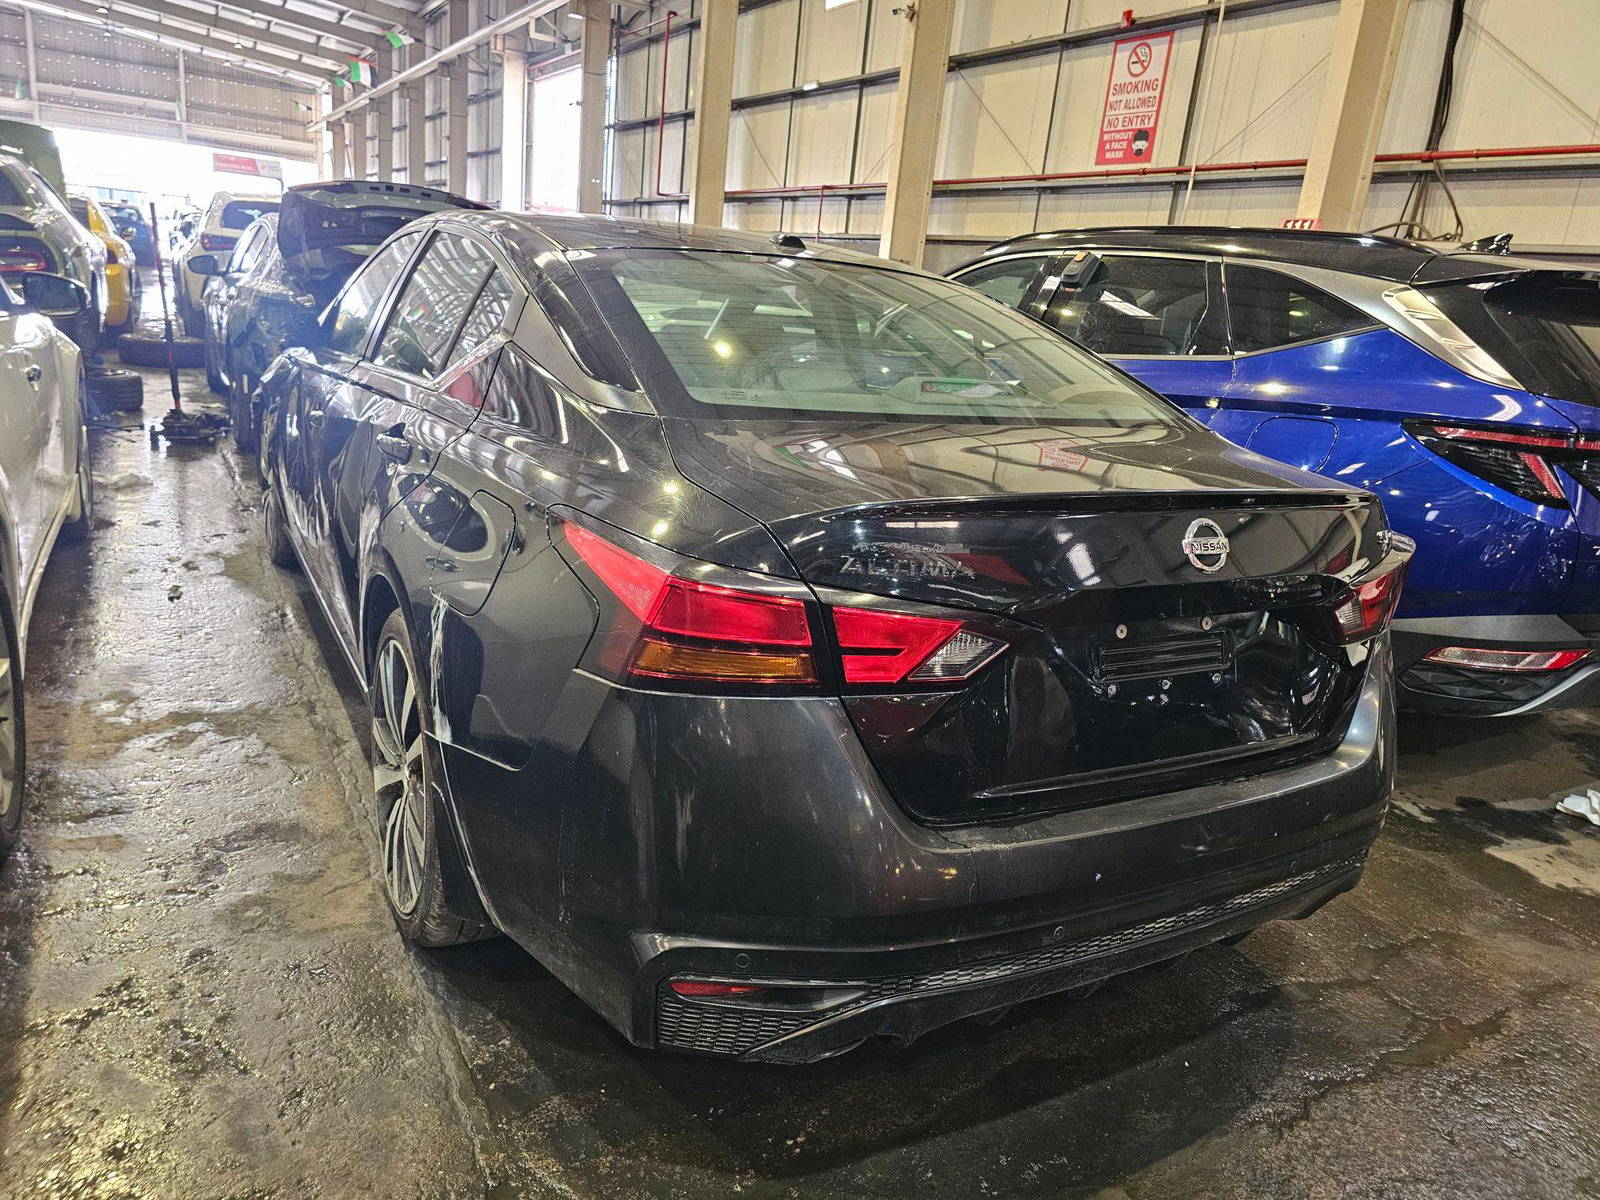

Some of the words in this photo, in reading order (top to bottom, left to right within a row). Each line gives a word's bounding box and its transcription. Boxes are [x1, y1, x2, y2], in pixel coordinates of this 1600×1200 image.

[1112, 79, 1159, 96] SMOKING
[1108, 99, 1123, 112] NOT
[1123, 96, 1157, 110] ALLOWED
[1106, 116, 1119, 129] NO
[1121, 114, 1153, 128] ENTRY
[1103, 131, 1133, 141] WITHOUT
[1111, 141, 1127, 150] FACE
[1104, 150, 1125, 159] MASK
[1191, 541, 1227, 552] NISSAN
[840, 555, 975, 579] ALTIMA
